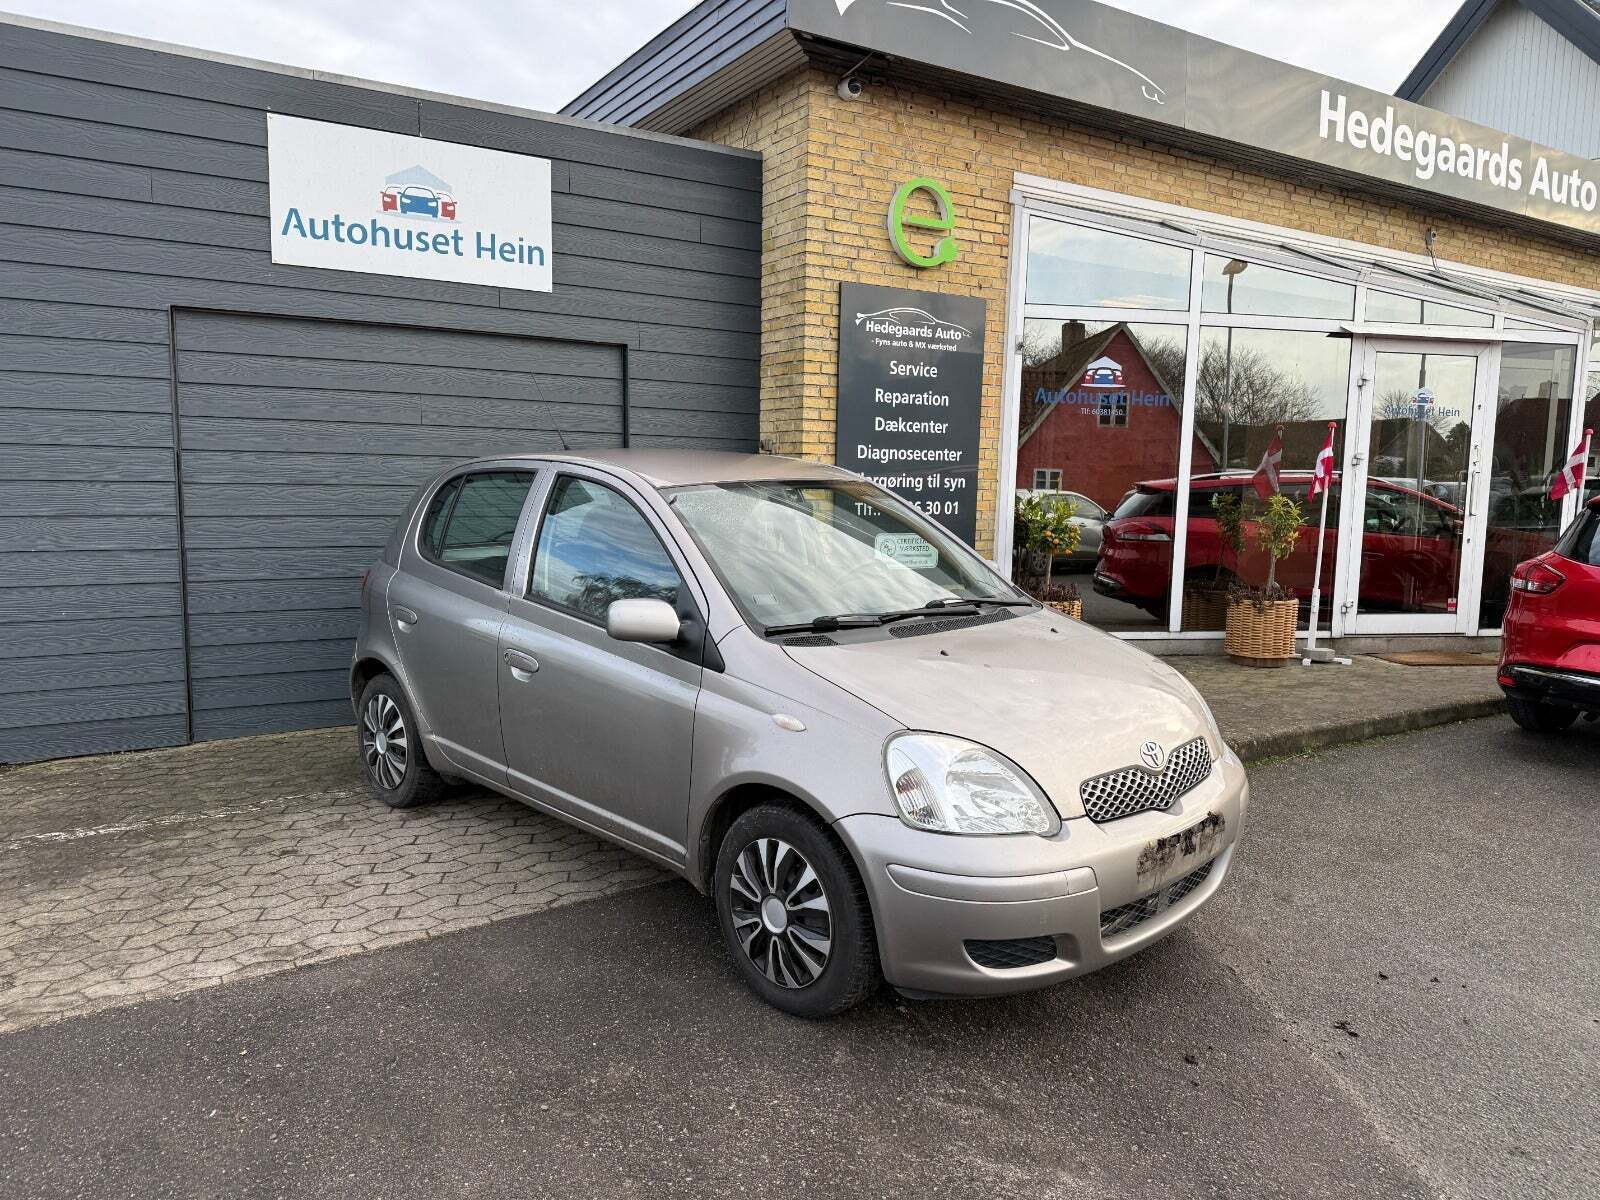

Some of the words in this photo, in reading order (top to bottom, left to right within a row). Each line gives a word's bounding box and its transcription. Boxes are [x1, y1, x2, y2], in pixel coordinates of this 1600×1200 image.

[1319, 89, 1523, 191] Hedegaards
[1529, 156, 1598, 211] Auto
[281, 207, 464, 257] Autohuset
[475, 231, 545, 267] Hein
[865, 320, 933, 338] Hedegaards
[935, 327, 962, 341] Auto
[875, 337, 891, 348] Fyns
[891, 339, 908, 348] auto
[908, 340, 914, 348] &
[915, 341, 927, 349] MX
[927, 342, 957, 352] værksted
[889, 360, 938, 378] Service
[875, 388, 949, 408] Reparation
[1034, 386, 1129, 405] Autohuset
[1132, 389, 1170, 407] Hein
[1438, 406, 1460, 417] Hein
[874, 416, 949, 434] Dækcenter
[857, 444, 963, 463] Diagnosecenter
[857, 472, 923, 491] rgøring
[926, 473, 940, 488] til
[943, 477, 966, 492] syn
[925, 501, 941, 515] 30
[944, 501, 959, 515] 01
